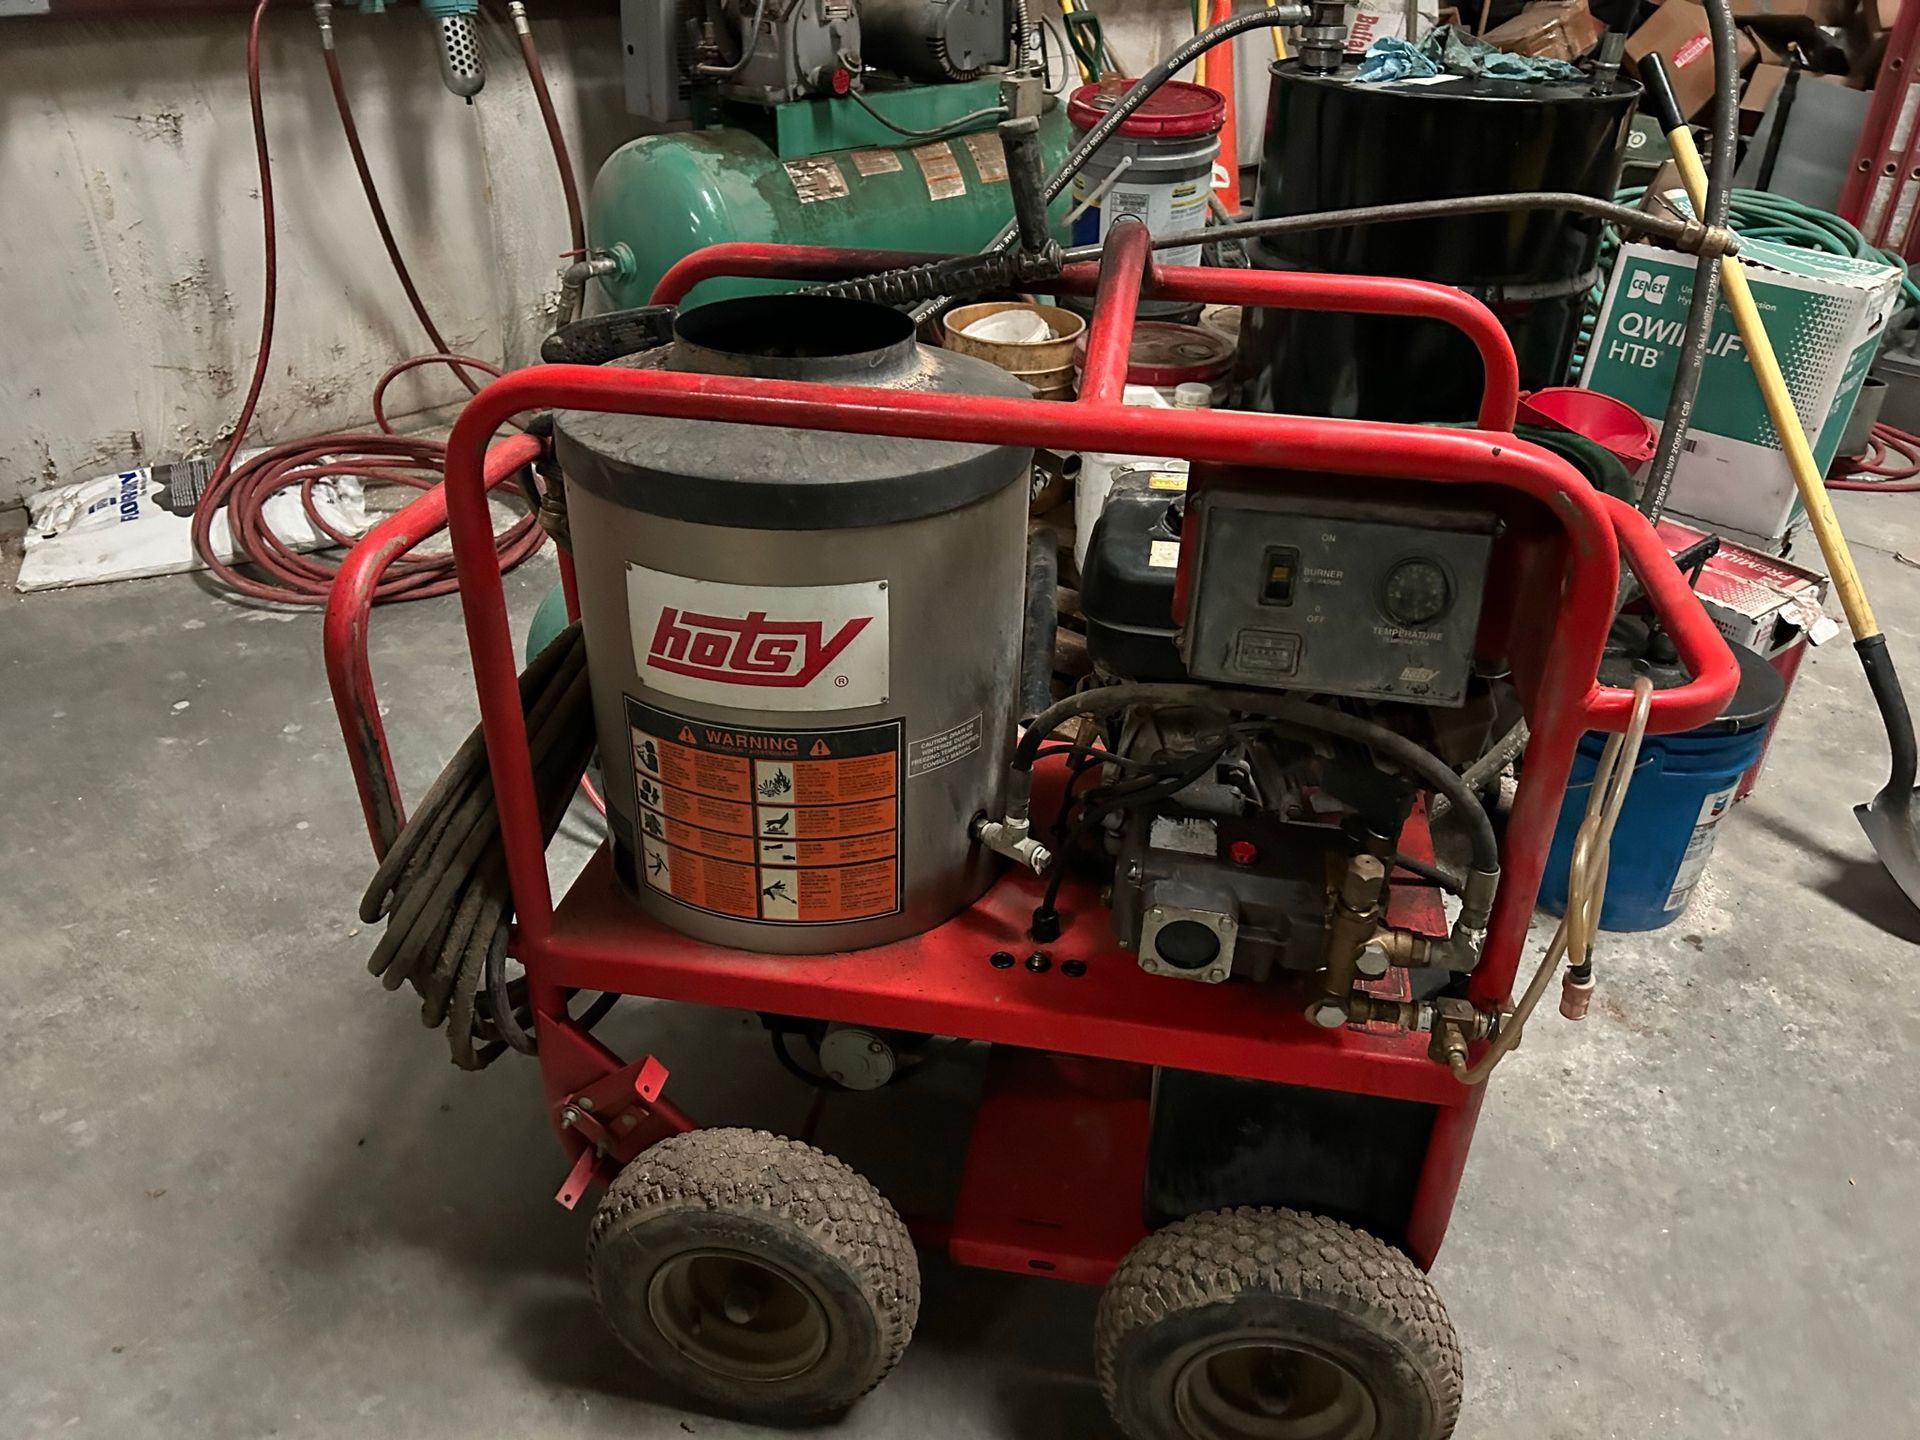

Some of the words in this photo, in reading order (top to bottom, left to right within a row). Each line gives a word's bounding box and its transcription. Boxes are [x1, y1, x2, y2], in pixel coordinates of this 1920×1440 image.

[1631, 278, 1665, 296] CENEX
[1608, 339, 1657, 369] HTB
[1655, 485, 1668, 508] 2250
[1665, 454, 1676, 471] WP
[1681, 400, 1692, 418] CSI
[1321, 533, 1337, 543] ON
[1303, 567, 1344, 580] BURNER
[1306, 614, 1326, 624] OFF
[1372, 626, 1444, 642] TEMPERATURE
[705, 728, 799, 751] WARNING
[922, 754, 950, 770] CONSULT
